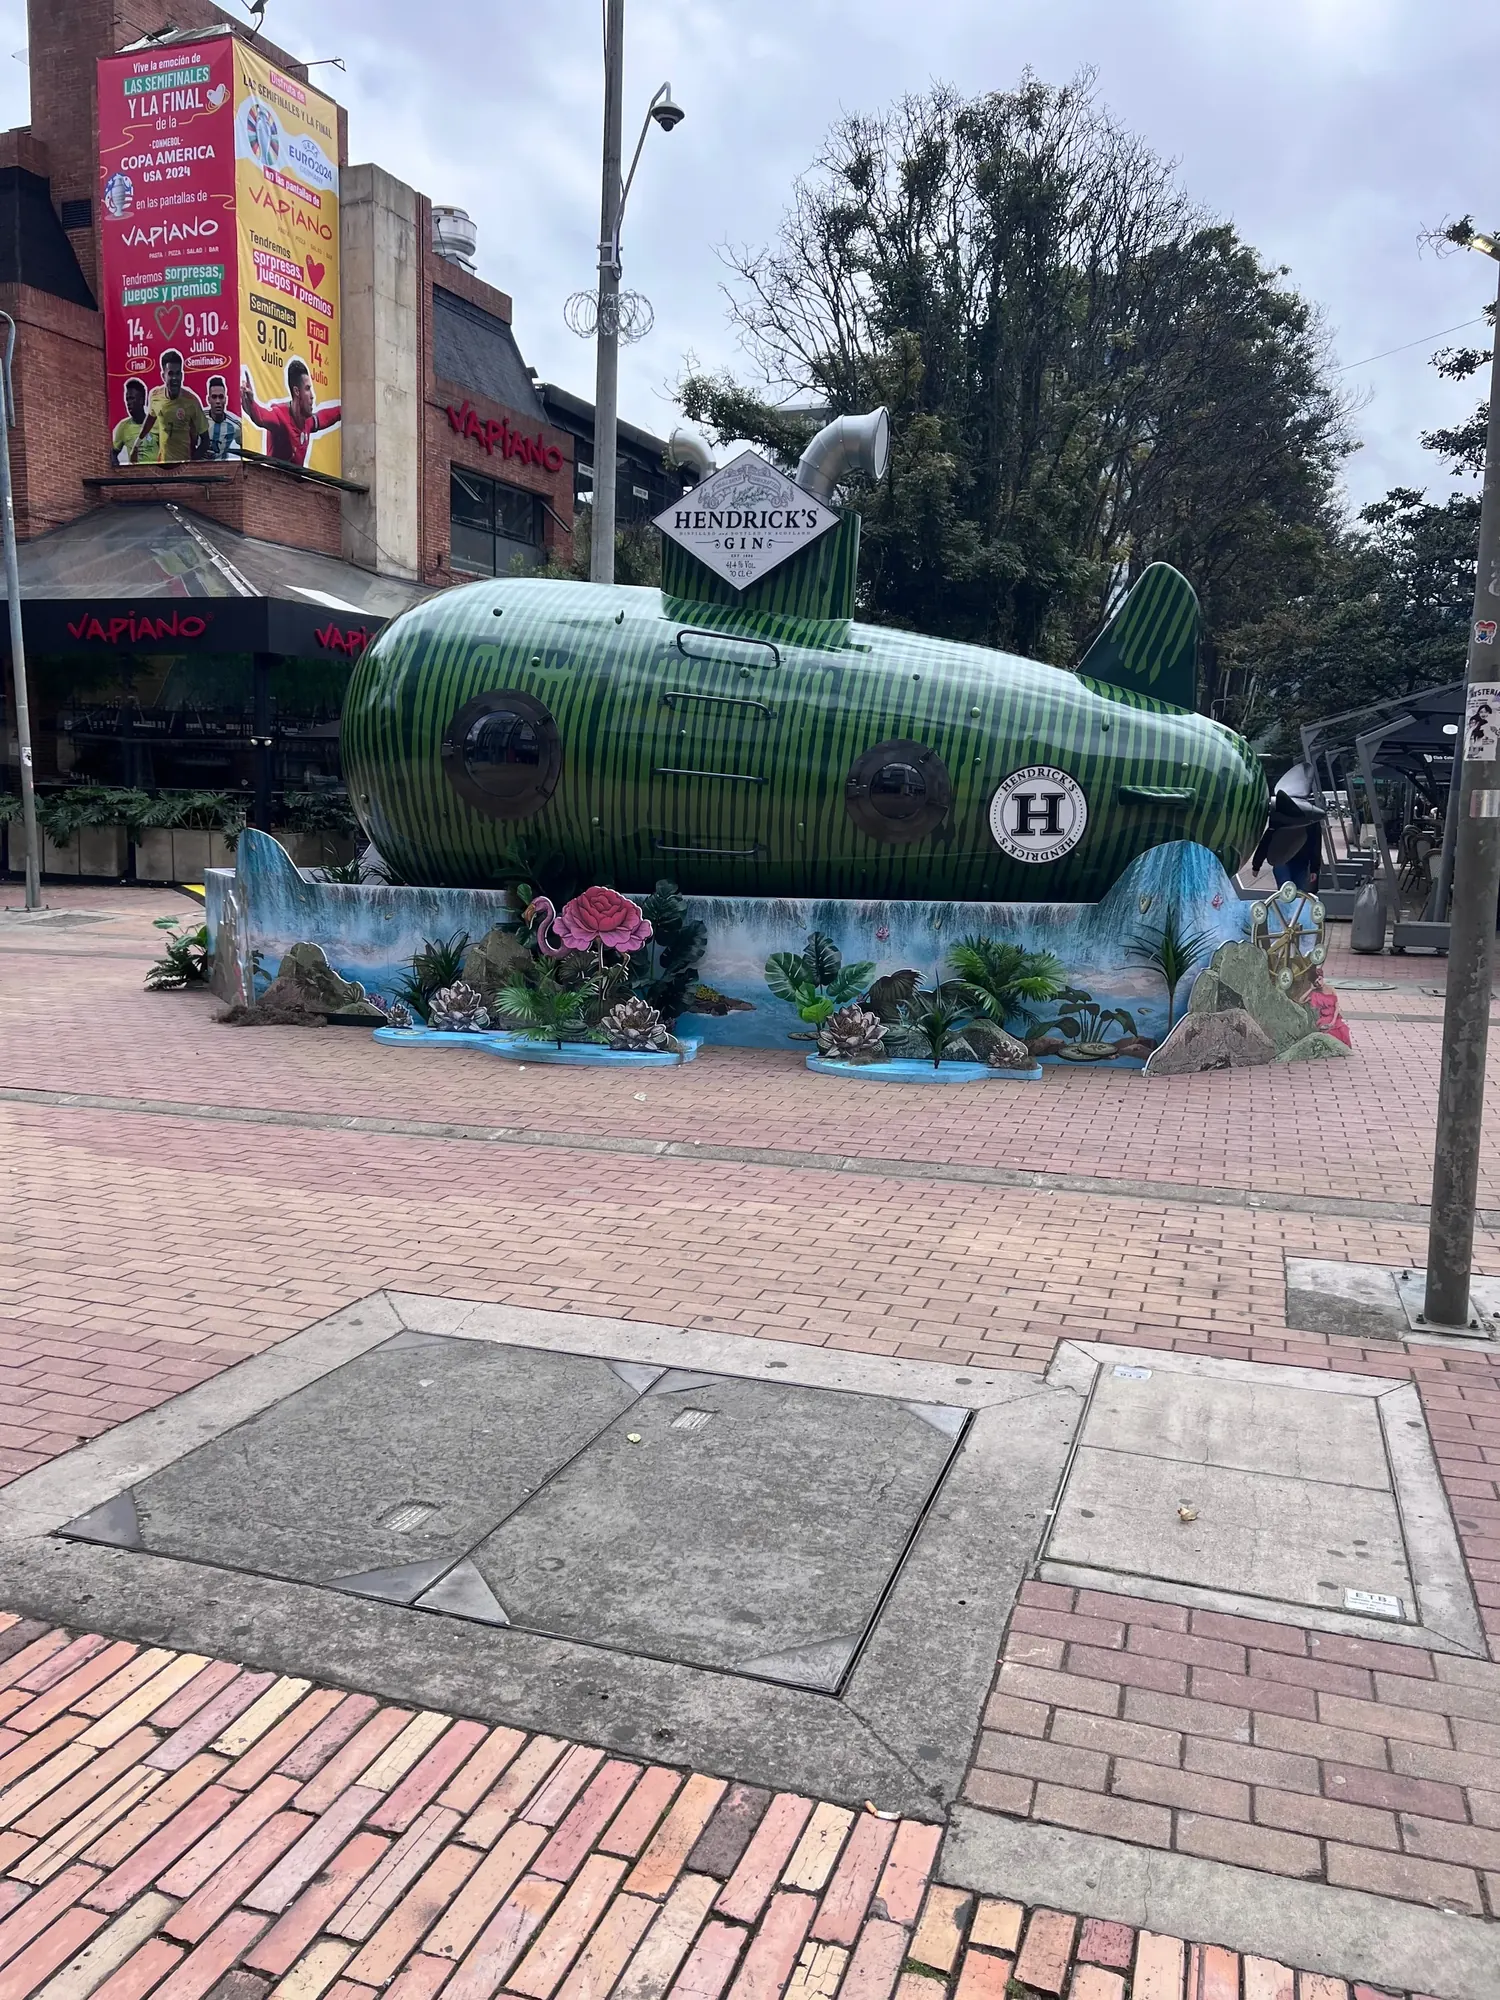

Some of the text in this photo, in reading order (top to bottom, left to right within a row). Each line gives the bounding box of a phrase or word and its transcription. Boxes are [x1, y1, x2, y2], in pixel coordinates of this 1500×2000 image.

[133, 53, 201, 73] Vive la emoción de
[124, 67, 209, 95] LAS SEMIFINALES
[128, 87, 204, 119] Y LA FINAL
[258, 83, 300, 119] SEMIFINALES
[306, 113, 315, 128] LA
[316, 119, 332, 139] FINAL
[156, 115, 177, 131] de la
[121, 145, 216, 171] COPA AMERICA
[289, 145, 333, 182] EURO2024
[143, 165, 191, 182] USA 2024
[136, 190, 208, 210] en las pantallas de
[265, 168, 320, 207] en las pantallas de
[249, 229, 291, 258] Tendremos
[122, 266, 223, 286] Tendremos sorpresas,
[254, 250, 303, 280] sorpresas,
[123, 279, 218, 307] juegos y premios
[258, 263, 332, 316] juegos y premios
[251, 296, 295, 325] Semifinales
[126, 318, 144, 342] 14
[184, 313, 195, 337] 9
[200, 311, 219, 336] 10
[257, 320, 266, 344] 9
[272, 325, 287, 352] 10
[309, 321, 326, 341] Final
[126, 343, 149, 358] Julio
[190, 338, 215, 353] Julio
[309, 340, 322, 367] 14
[131, 360, 146, 371] Final
[187, 356, 224, 367] Semifinales
[261, 349, 284, 368] Julio
[310, 368, 329, 386] Julio
[674, 508, 817, 529] HENDRICK'S
[724, 537, 764, 549] GIN
[1001, 767, 1077, 793] HENDRICK'S
[1011, 793, 1066, 836] H
[999, 837, 1076, 861] HENDRICK'S
